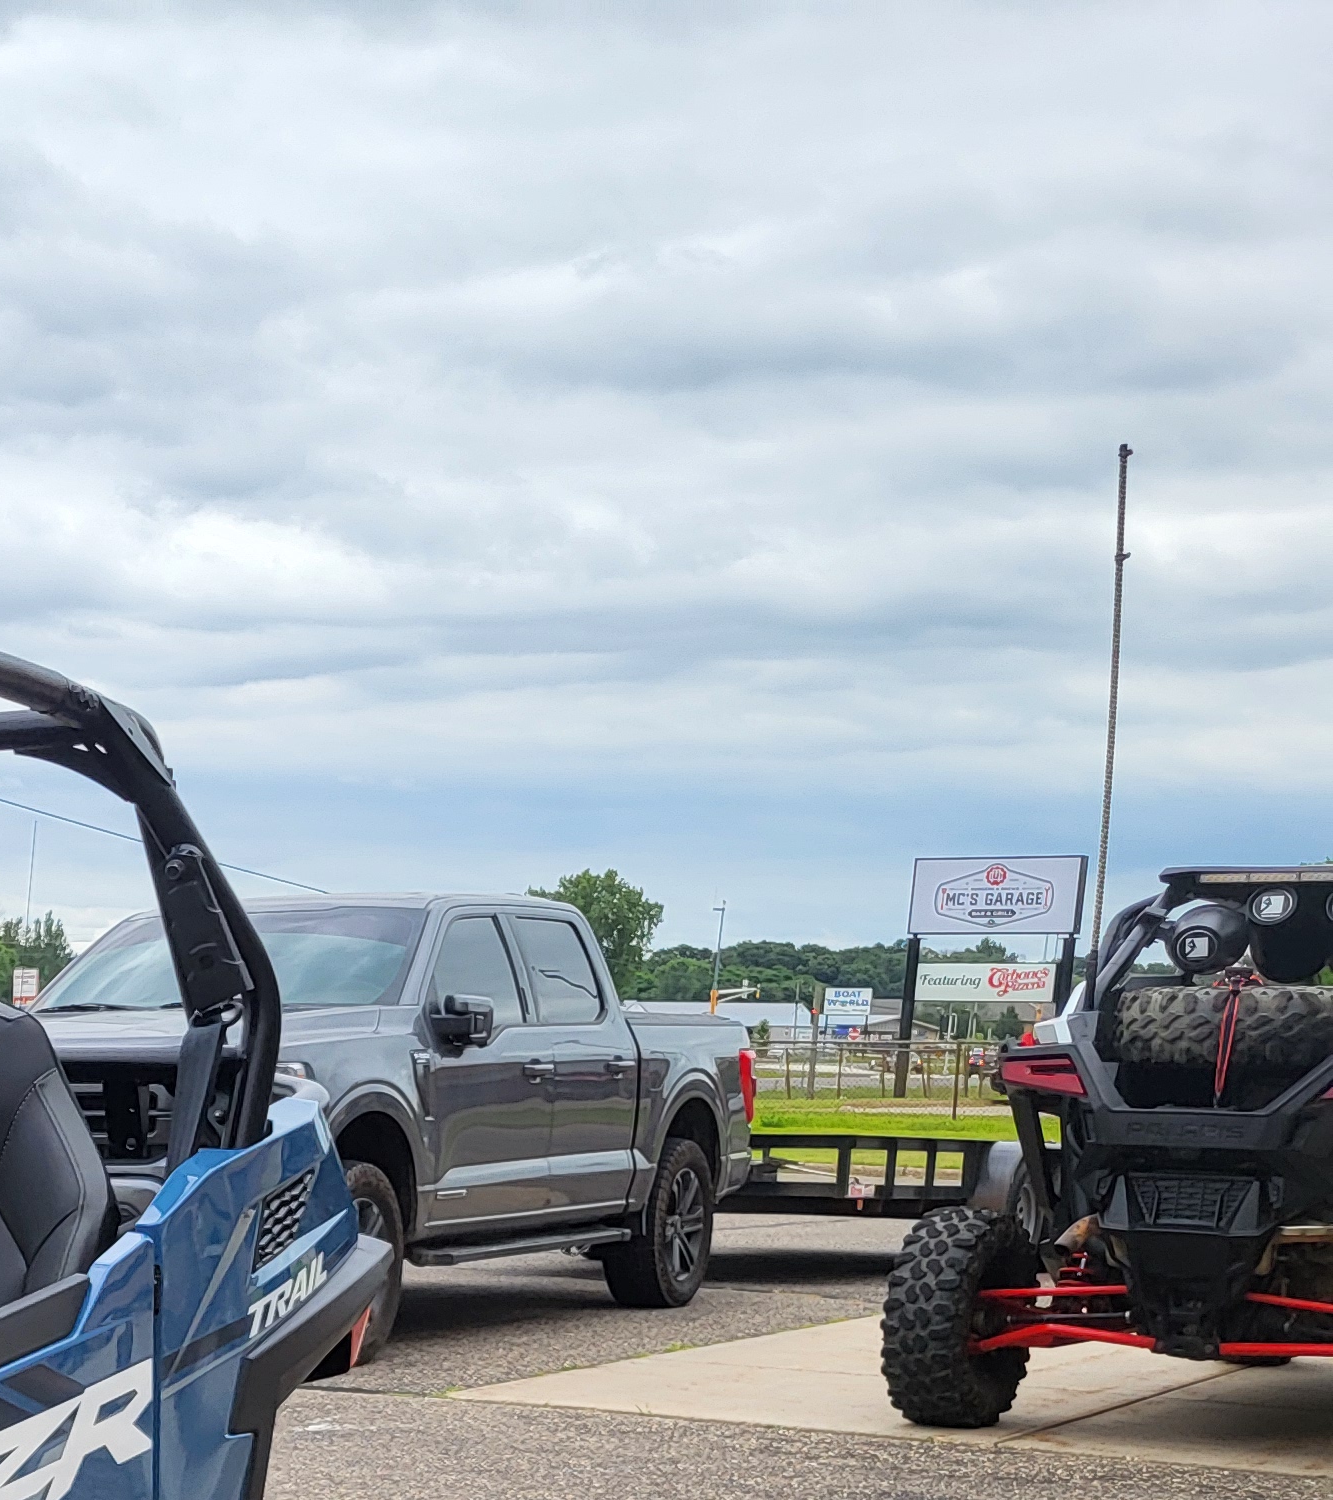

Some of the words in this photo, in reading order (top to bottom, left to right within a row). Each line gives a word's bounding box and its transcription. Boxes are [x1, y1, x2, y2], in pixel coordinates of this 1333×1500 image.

[945, 891, 979, 906] MC'S
[985, 891, 1044, 906] GARAGE
[919, 973, 982, 989] Featuring
[834, 990, 863, 998] BOAT
[247, 1251, 328, 1339] TRAIL
